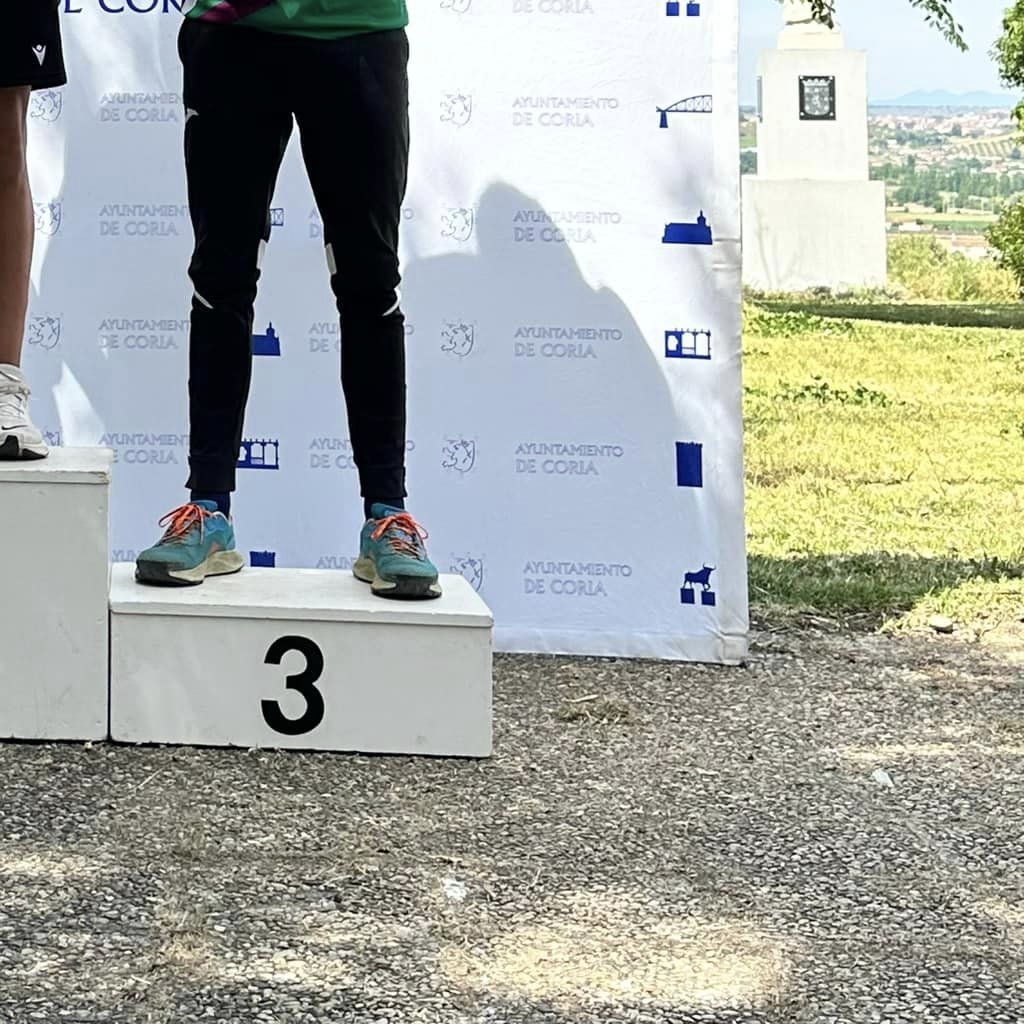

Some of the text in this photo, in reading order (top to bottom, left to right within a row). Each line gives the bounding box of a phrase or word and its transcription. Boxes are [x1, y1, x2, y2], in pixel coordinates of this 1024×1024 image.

[512, 96, 620, 110] AYUNTAMIENTO
[100, 108, 179, 123] DE CORIA
[512, 112, 594, 128] DE CORIA
[513, 210, 622, 224] AYUNTAMIENTO
[99, 221, 179, 236] DE CORIA
[513, 227, 597, 244] DE CORIA
[124, 334, 179, 350] CORIA
[514, 326, 624, 342] AYUNTAMIENTO
[309, 338, 329, 353] DE
[514, 342, 598, 359] DE CORIA
[124, 450, 179, 465] CORIA
[515, 442, 624, 458] AYUNTAMIENTO
[310, 454, 329, 468] DE
[516, 459, 599, 476] DE CORIA
[522, 561, 632, 577] AYUNTAMIENTO
[524, 578, 608, 597] DE CORIA
[260, 635, 326, 736] 3
